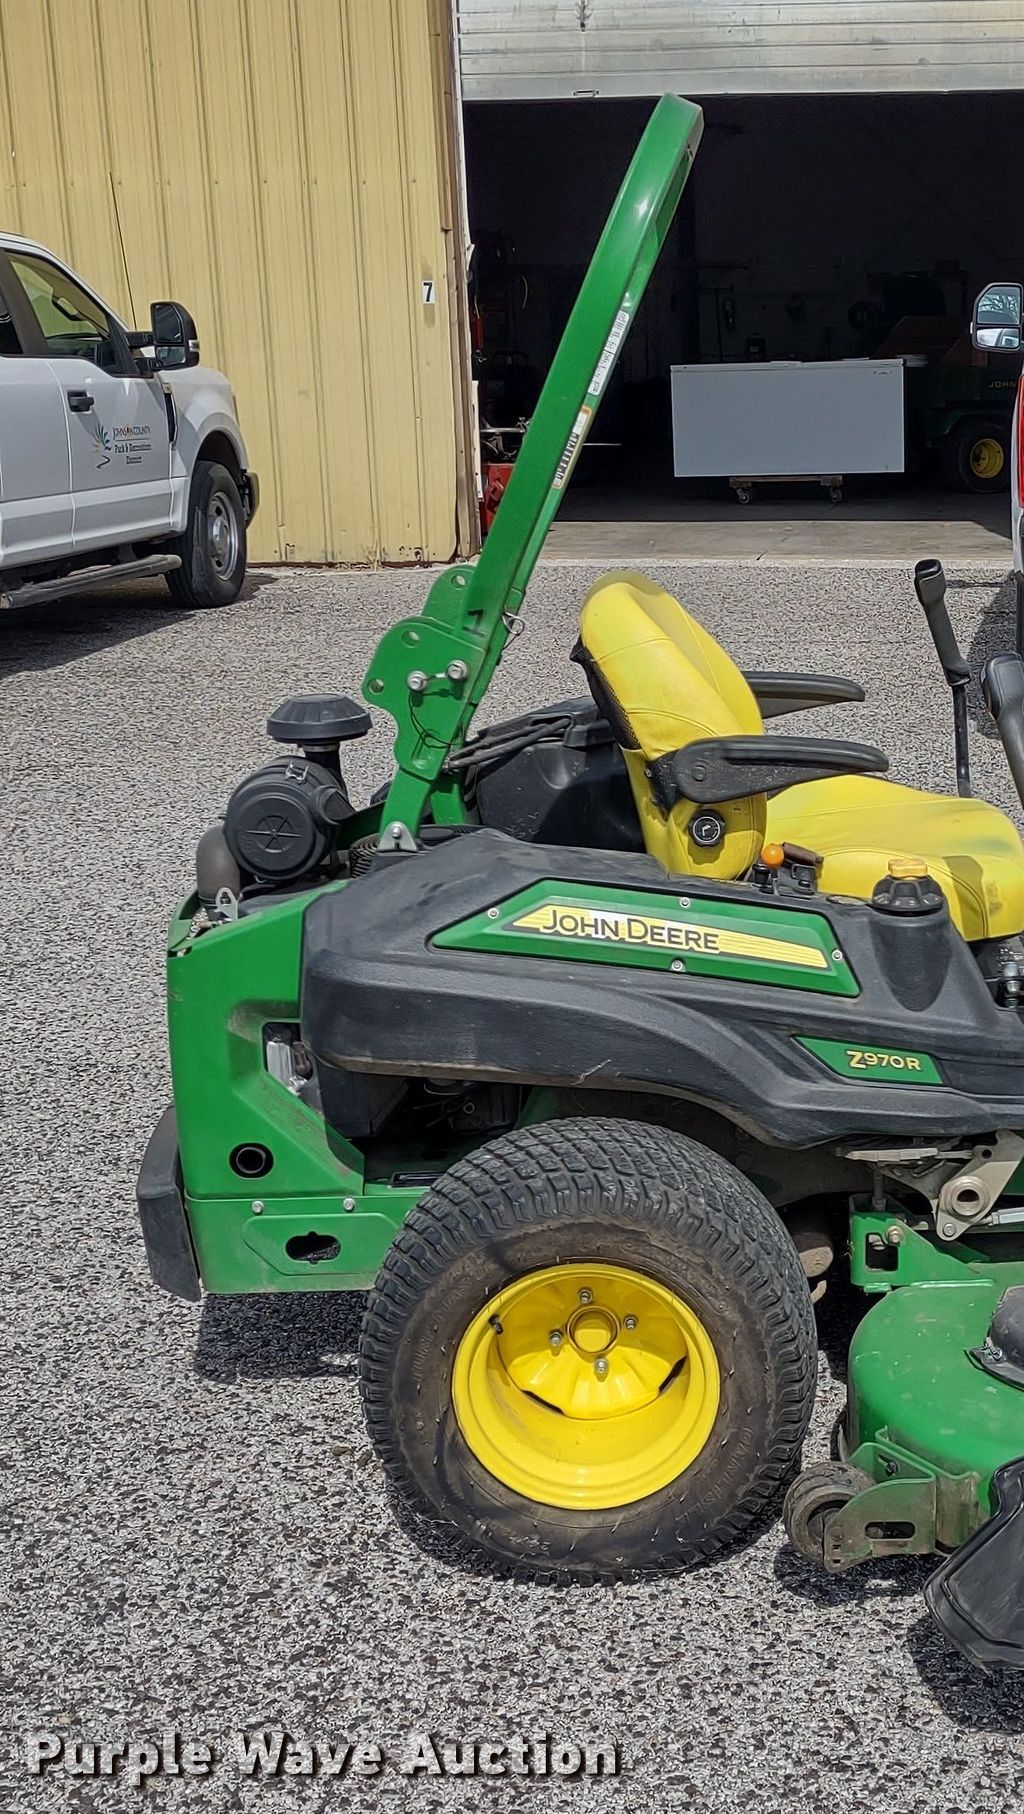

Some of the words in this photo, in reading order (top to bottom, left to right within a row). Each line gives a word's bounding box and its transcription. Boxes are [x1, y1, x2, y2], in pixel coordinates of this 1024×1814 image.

[422, 281, 433, 303] 7
[542, 909, 620, 938] JOHN
[626, 917, 720, 951] DEERE
[846, 1050, 922, 1071] Z970R
